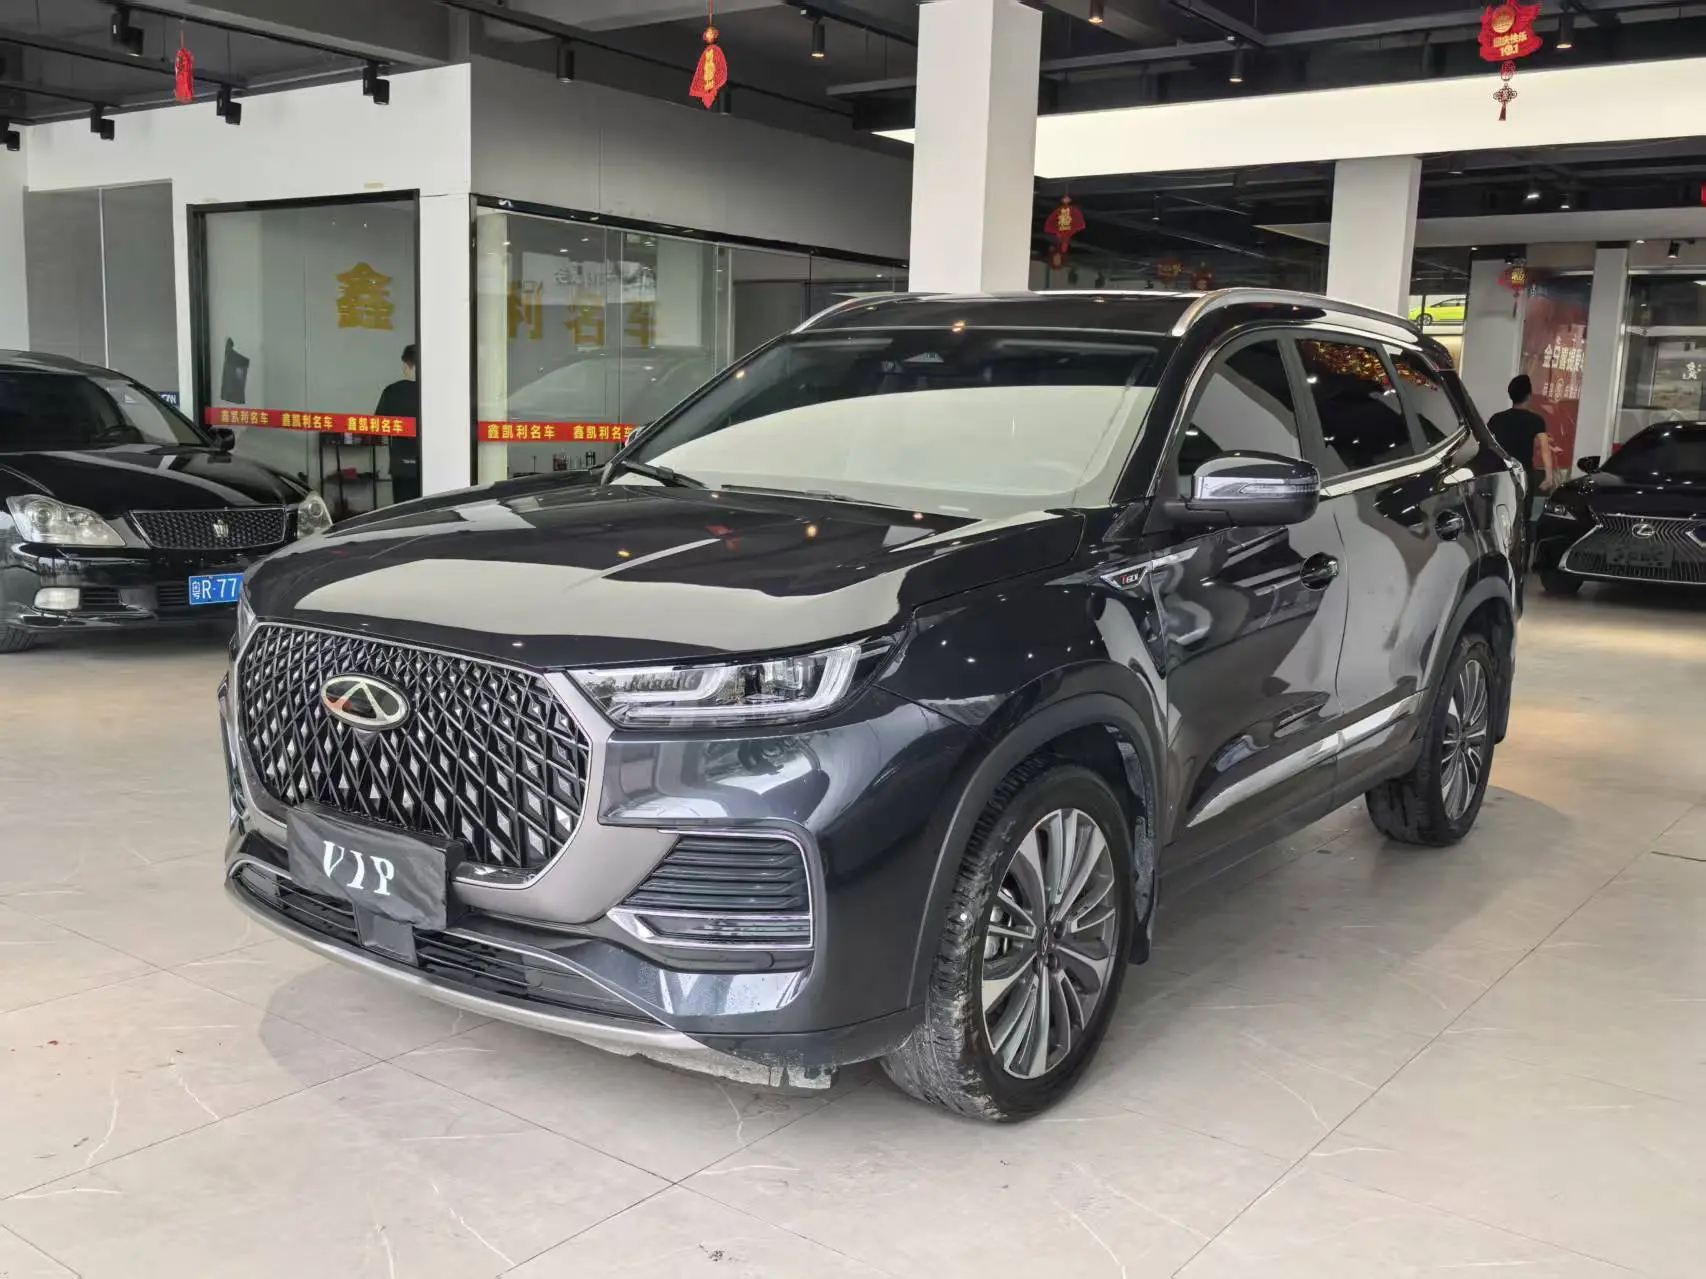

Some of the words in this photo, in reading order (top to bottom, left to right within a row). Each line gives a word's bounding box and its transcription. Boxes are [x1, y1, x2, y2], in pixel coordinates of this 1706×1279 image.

[335, 261, 395, 330] 鑫
[220, 408, 269, 425] 鑫凯利名车
[281, 412, 334, 429] 鑫凯利名车
[347, 416, 404, 433] 鑫凯利名车
[487, 423, 557, 440] 鑫凯利名车
[323, 840, 395, 896] VIP
